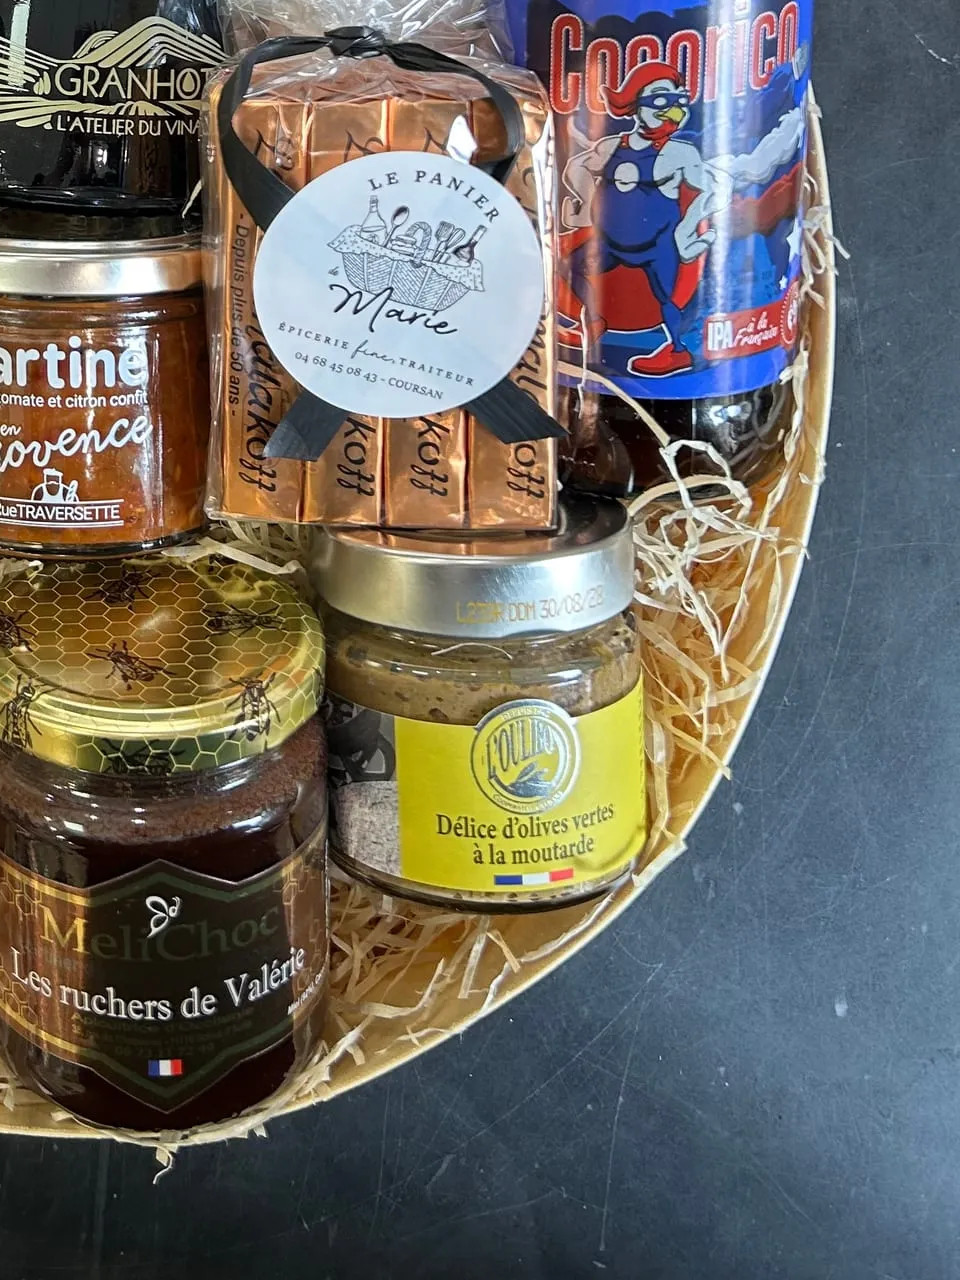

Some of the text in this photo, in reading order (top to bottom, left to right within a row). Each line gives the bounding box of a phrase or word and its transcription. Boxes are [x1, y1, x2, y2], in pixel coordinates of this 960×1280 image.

[56, 114, 134, 136] L'ATELIER
[139, 119, 161, 136] DU
[367, 171, 399, 191] LE
[414, 169, 500, 224] PANIER
[230, 225, 249, 281] Depuis
[231, 282, 247, 320] plus
[328, 283, 459, 336] Marie
[277, 321, 350, 350] ÉPICERIE
[398, 357, 475, 387] TRAITEUR
[707, 320, 733, 351] IPA
[230, 352, 243, 372] 50
[294, 351, 444, 401] 04 68 45 08 43 COURSAN
[47, 394, 62, 408] et
[65, 394, 107, 408] citron
[109, 388, 149, 408] confit
[229, 376, 241, 404] ans
[0, 424, 21, 436] en
[435, 803, 614, 840] Délice d'olives vertes
[473, 834, 595, 865] à la moutarde
[39, 903, 280, 962] MeliChoc
[10, 946, 52, 999] Les
[59, 985, 172, 1021] ruchers
[180, 987, 217, 1019] de
[223, 946, 305, 1007] Valérie
